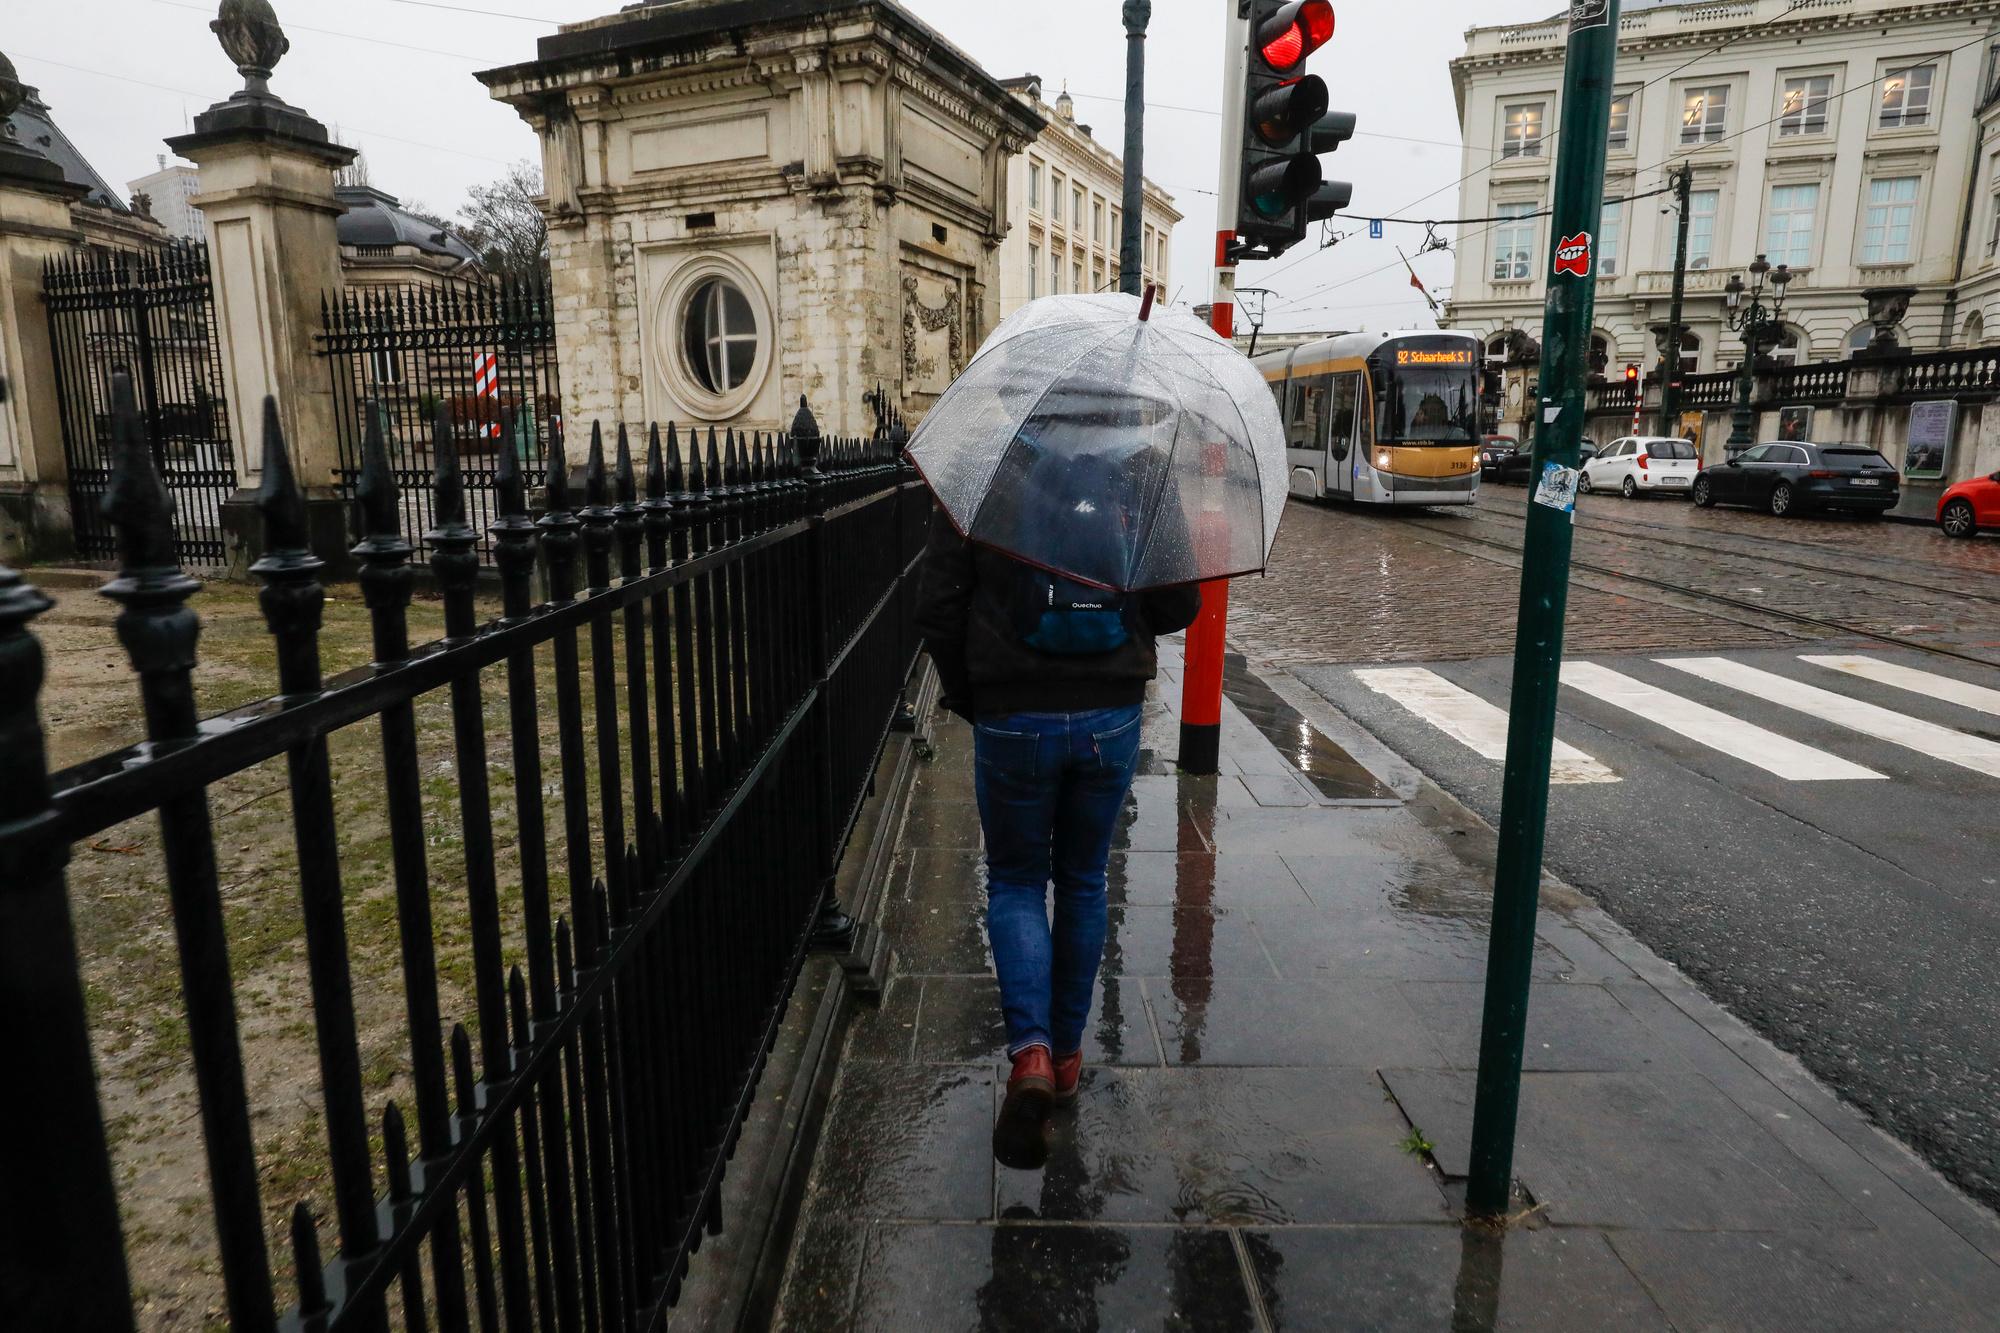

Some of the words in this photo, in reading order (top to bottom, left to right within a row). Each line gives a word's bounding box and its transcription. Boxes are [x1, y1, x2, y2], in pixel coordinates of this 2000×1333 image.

[1398, 351, 1408, 364] 92
[1411, 351, 1456, 363] Schaarbeek
[1450, 461, 1467, 470] 3136
